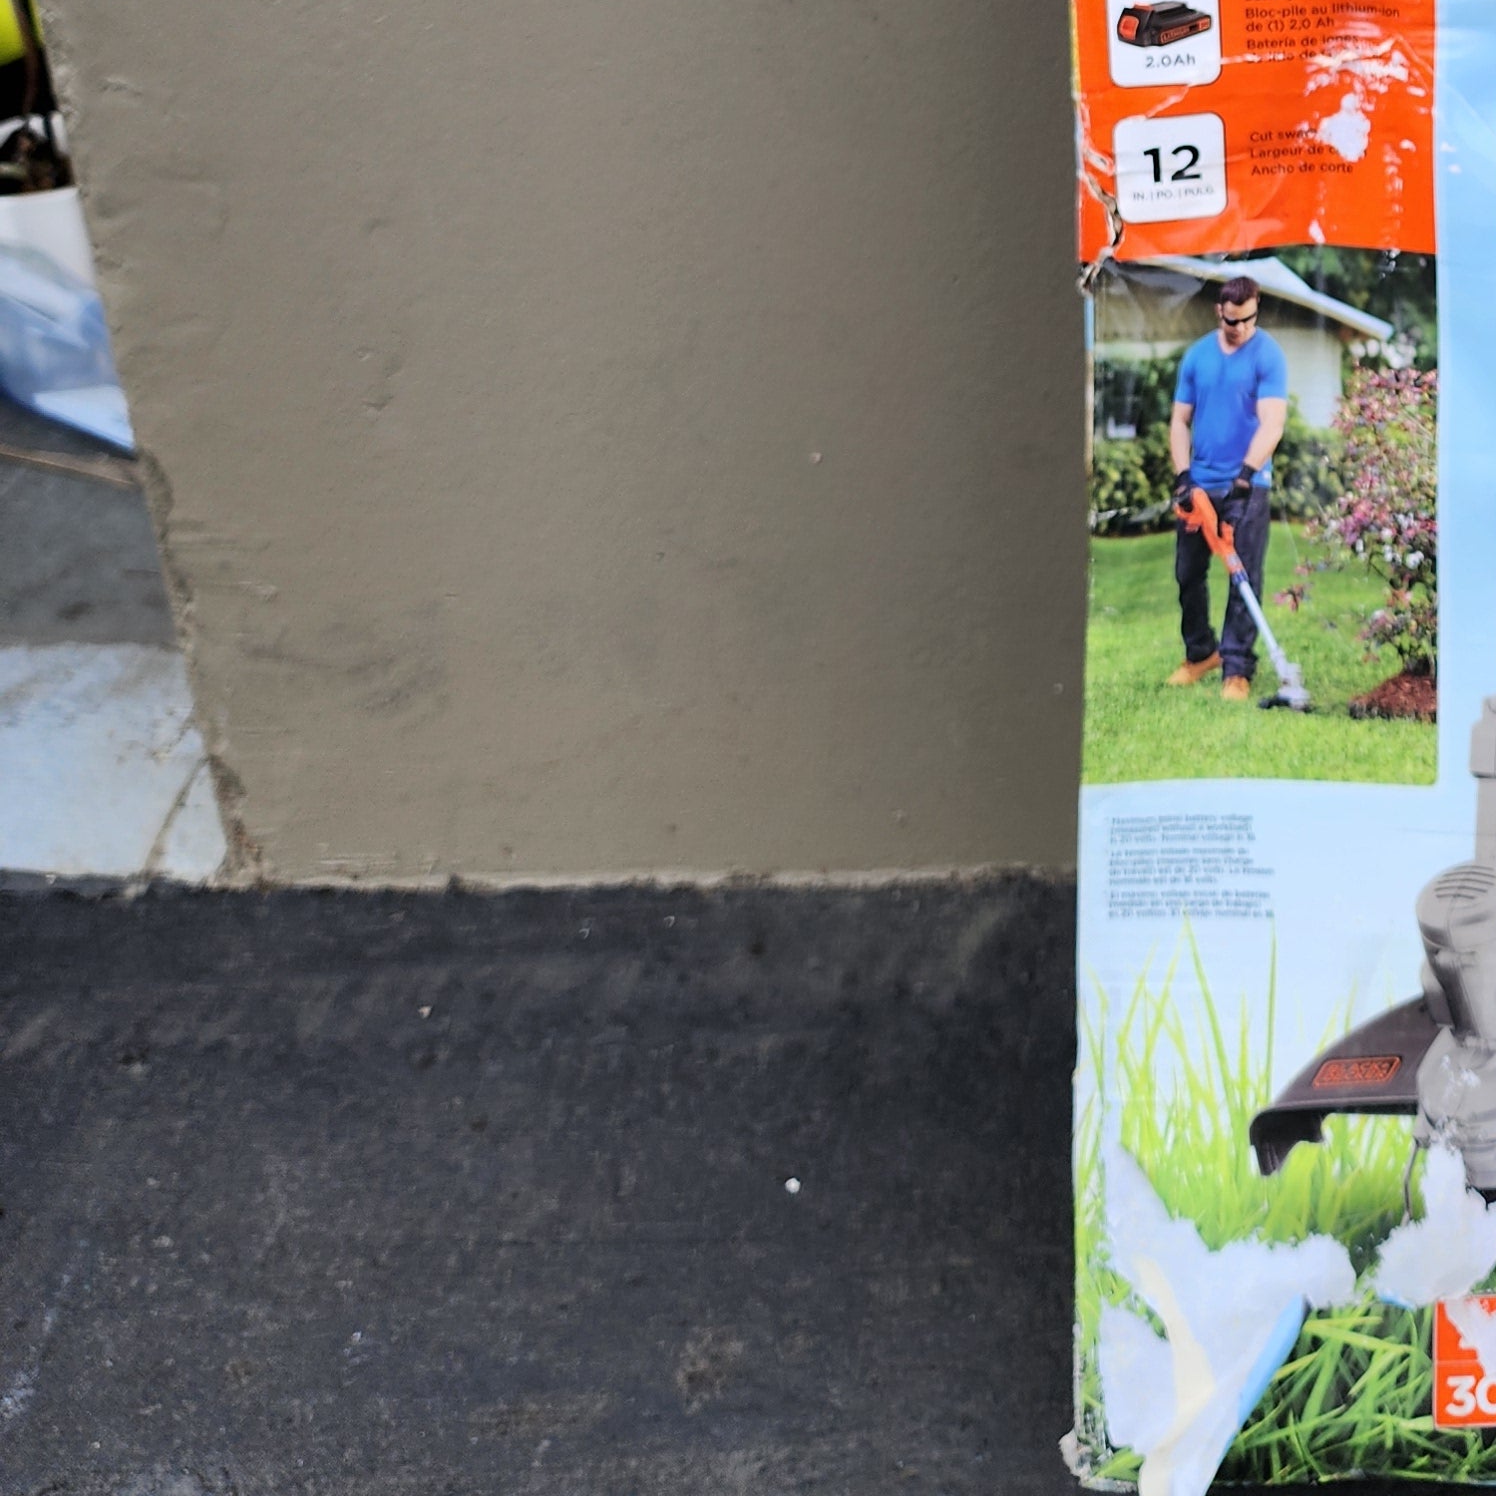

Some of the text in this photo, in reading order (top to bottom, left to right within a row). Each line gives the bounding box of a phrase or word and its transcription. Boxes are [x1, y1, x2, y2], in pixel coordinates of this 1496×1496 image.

[1245, 2, 1400, 20] Bloc-pile au lithium-ion
[1246, 21, 1263, 32] de
[1268, 19, 1285, 33] (1)
[1316, 16, 1335, 28] Ah
[1246, 37, 1296, 50] Batería
[1301, 35, 1318, 47] de
[1146, 54, 1196, 68] 2.0Ah
[1250, 131, 1272, 142] Cut
[1250, 146, 1302, 159] Largeur
[1307, 145, 1324, 155] de
[1143, 144, 1201, 184] 12
[1251, 162, 1353, 176] Ancho de corte
